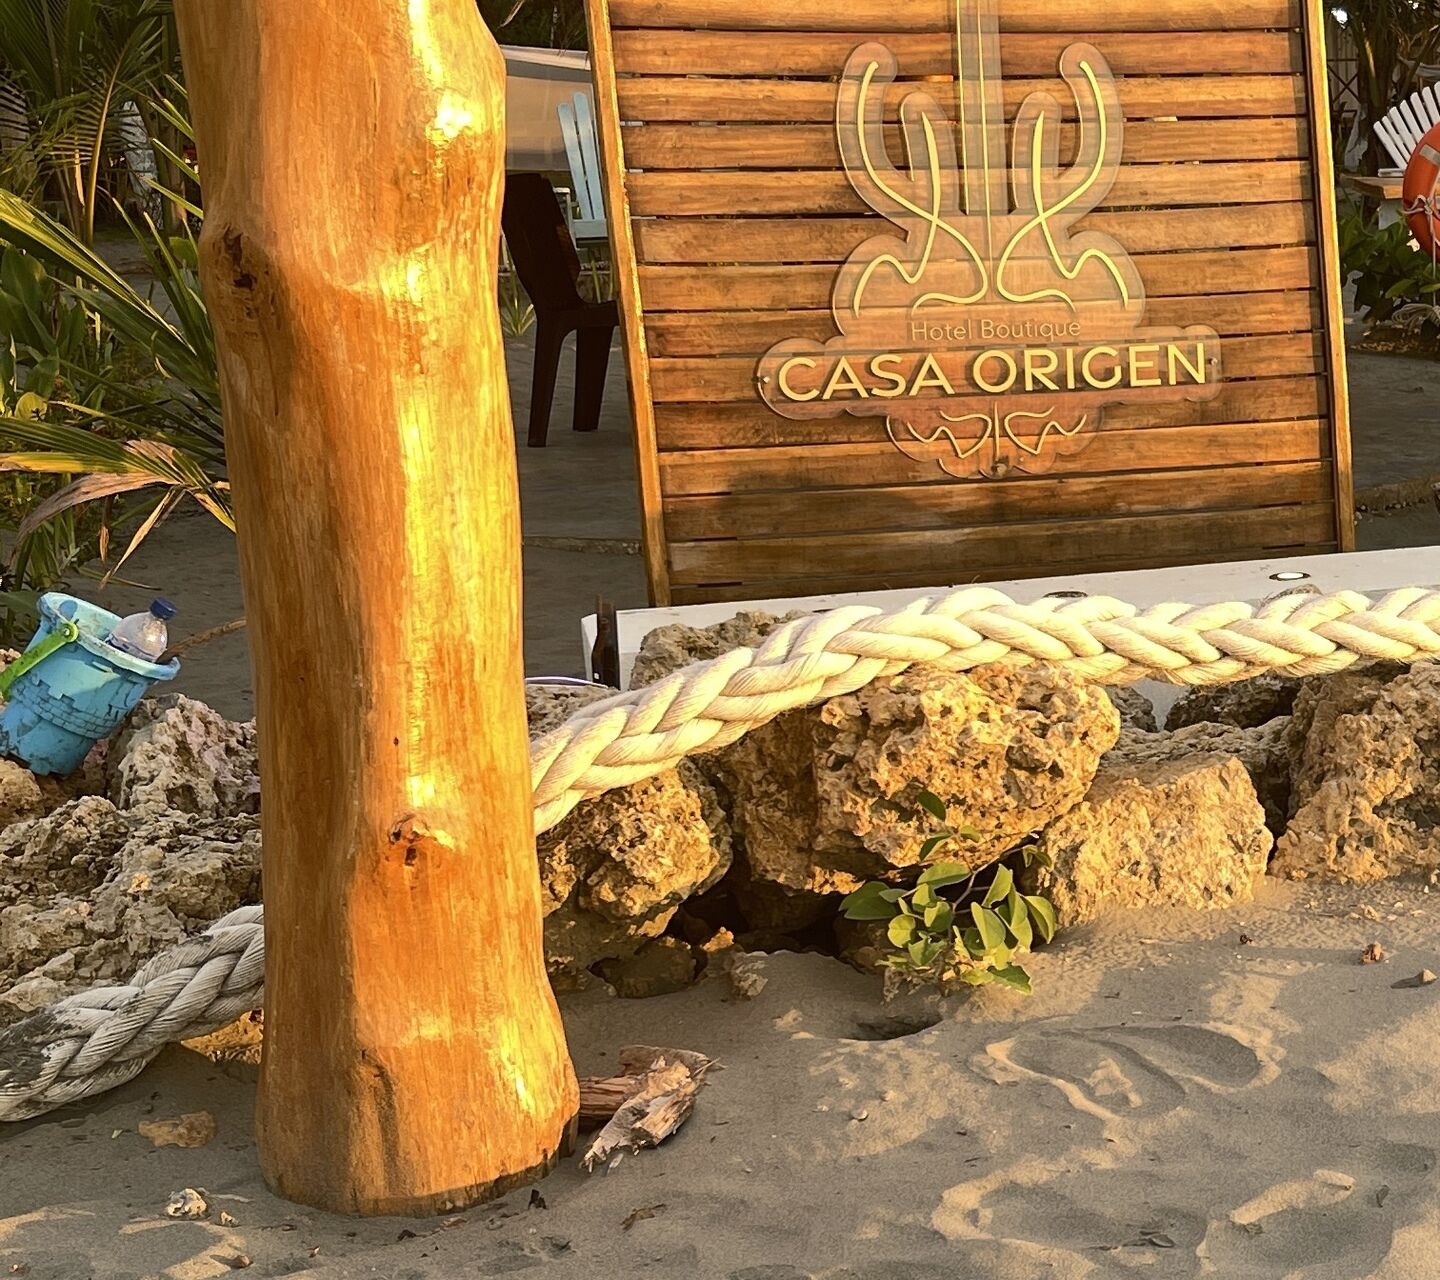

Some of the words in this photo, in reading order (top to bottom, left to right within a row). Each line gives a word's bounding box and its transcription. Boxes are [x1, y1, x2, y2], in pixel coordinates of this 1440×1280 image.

[911, 319, 972, 341] Hotel
[981, 318, 1081, 342] Boutique
[777, 353, 955, 401] CASA
[972, 343, 1206, 393] ORIGEN
